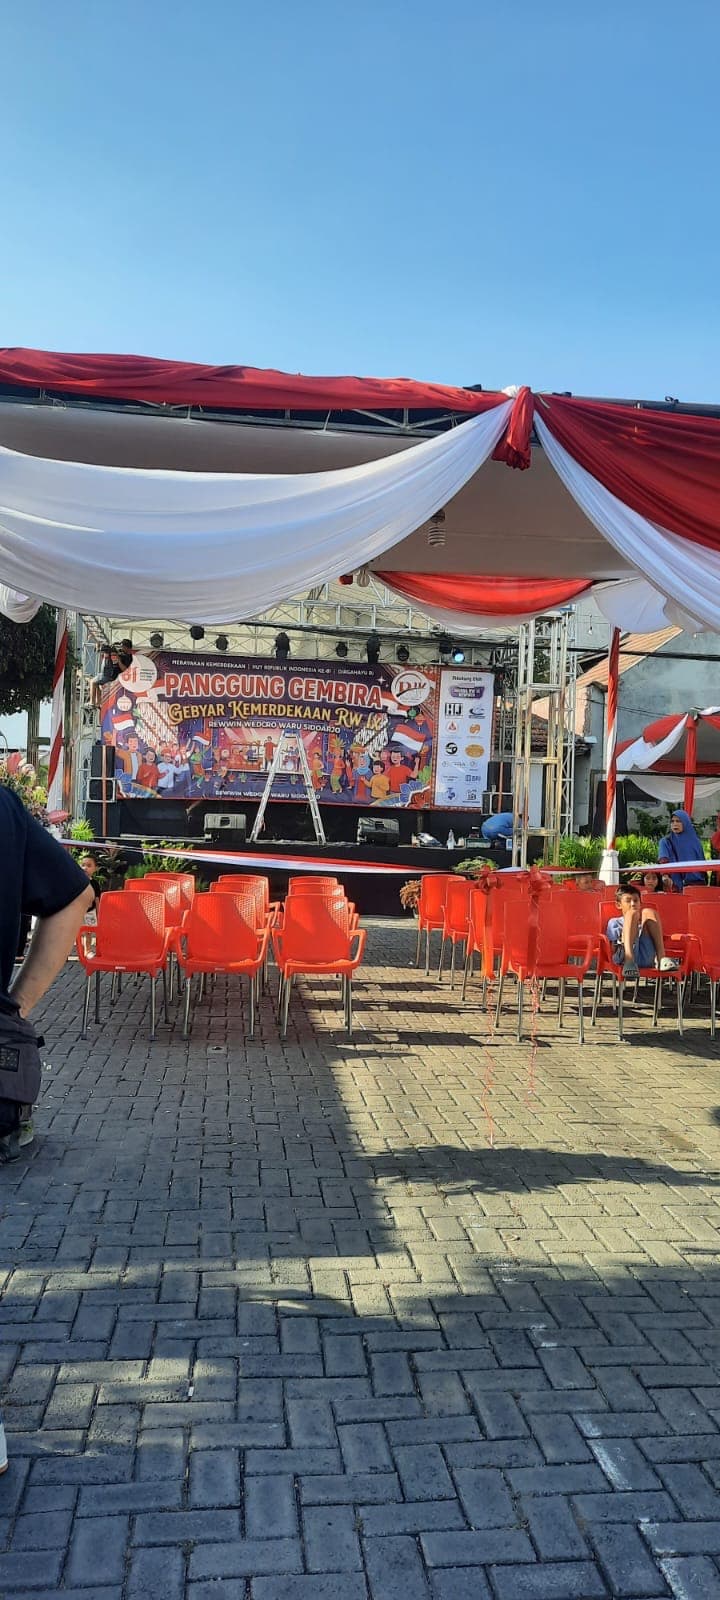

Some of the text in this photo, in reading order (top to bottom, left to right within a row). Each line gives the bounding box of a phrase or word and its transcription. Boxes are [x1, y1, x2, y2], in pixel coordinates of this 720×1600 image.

[206, 661, 246, 669] KEMERDEKAAN
[165, 673, 285, 699] PANGGUNG
[289, 677, 383, 709] GEMBIRA
[168, 703, 225, 725] GEBYAR
[228, 701, 331, 720] KEMERDEKAAN
[335, 707, 363, 728] RW
[303, 723, 341, 734] SIDOARJO
